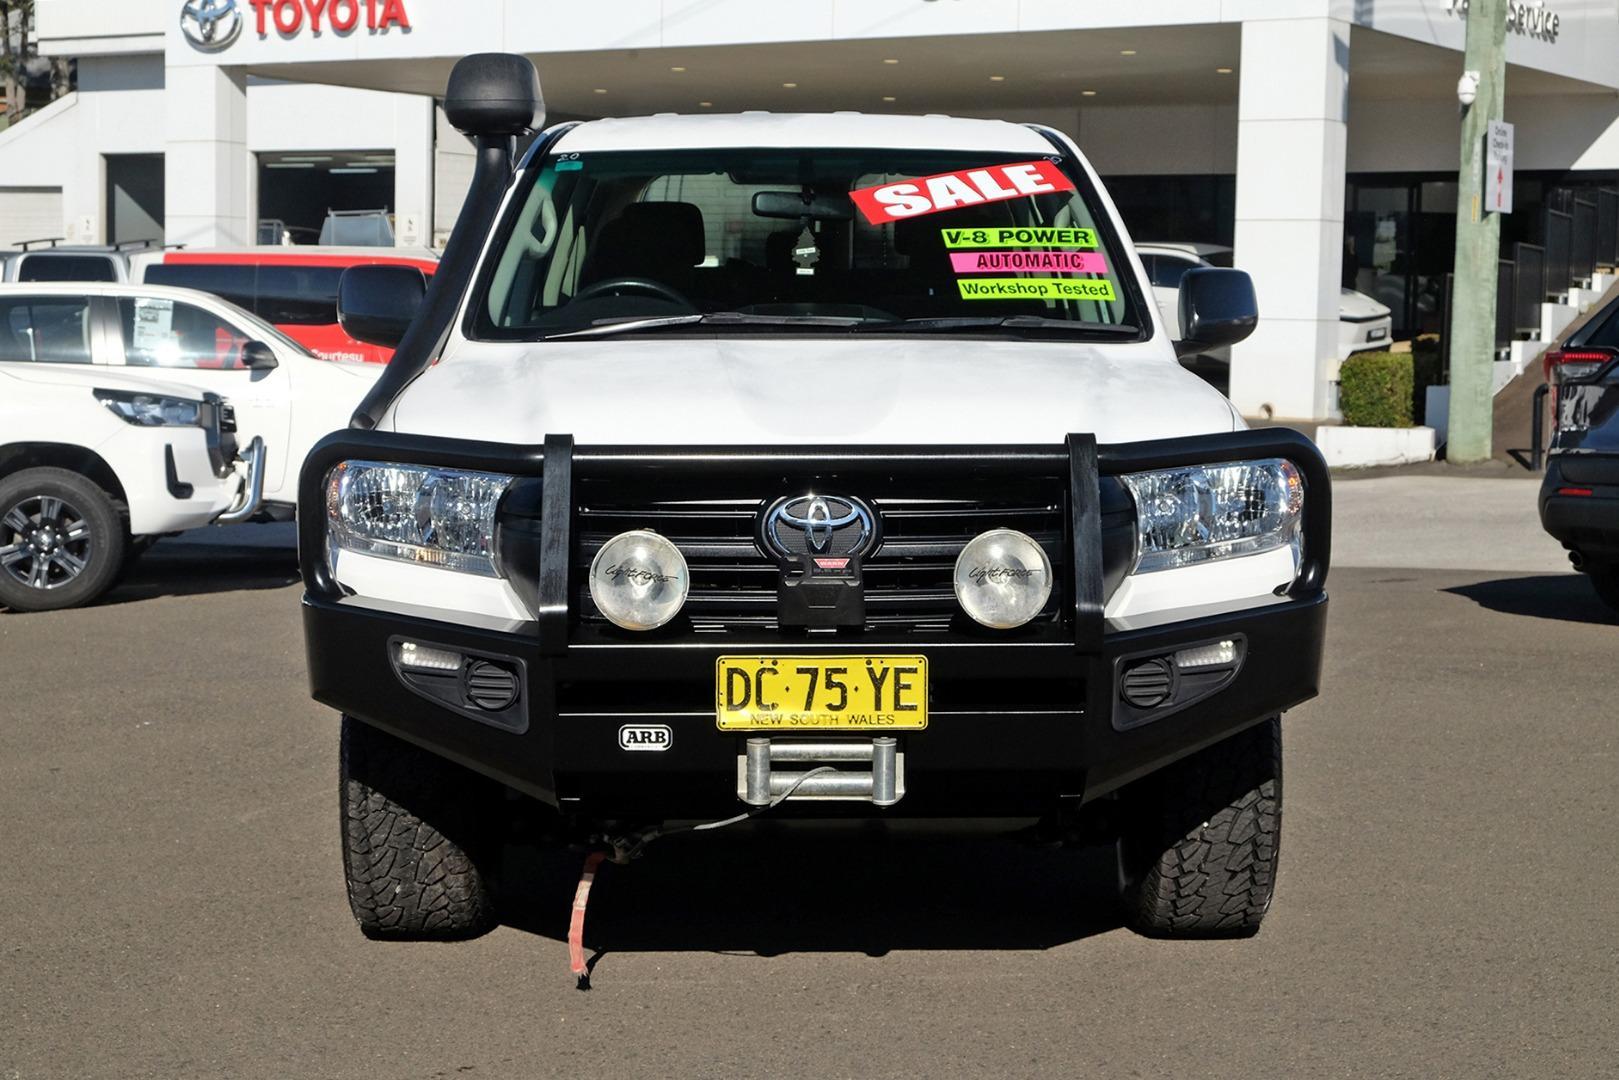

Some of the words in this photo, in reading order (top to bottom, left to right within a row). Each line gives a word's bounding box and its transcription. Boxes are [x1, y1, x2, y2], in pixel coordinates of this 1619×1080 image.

[249, 0, 411, 34] TOYOTA
[1506, 0, 1559, 37] Service
[873, 164, 1055, 217] SALE
[946, 230, 988, 244] V-8
[999, 229, 1090, 244] POWER
[976, 253, 1084, 269] AUTOMATIC
[962, 283, 1049, 297] Workshop
[1053, 283, 1109, 297] Tested
[750, 714, 783, 725] NEW
[789, 714, 839, 725] SOUTH
[848, 714, 895, 725] WALES
[626, 731, 666, 744] ARB
